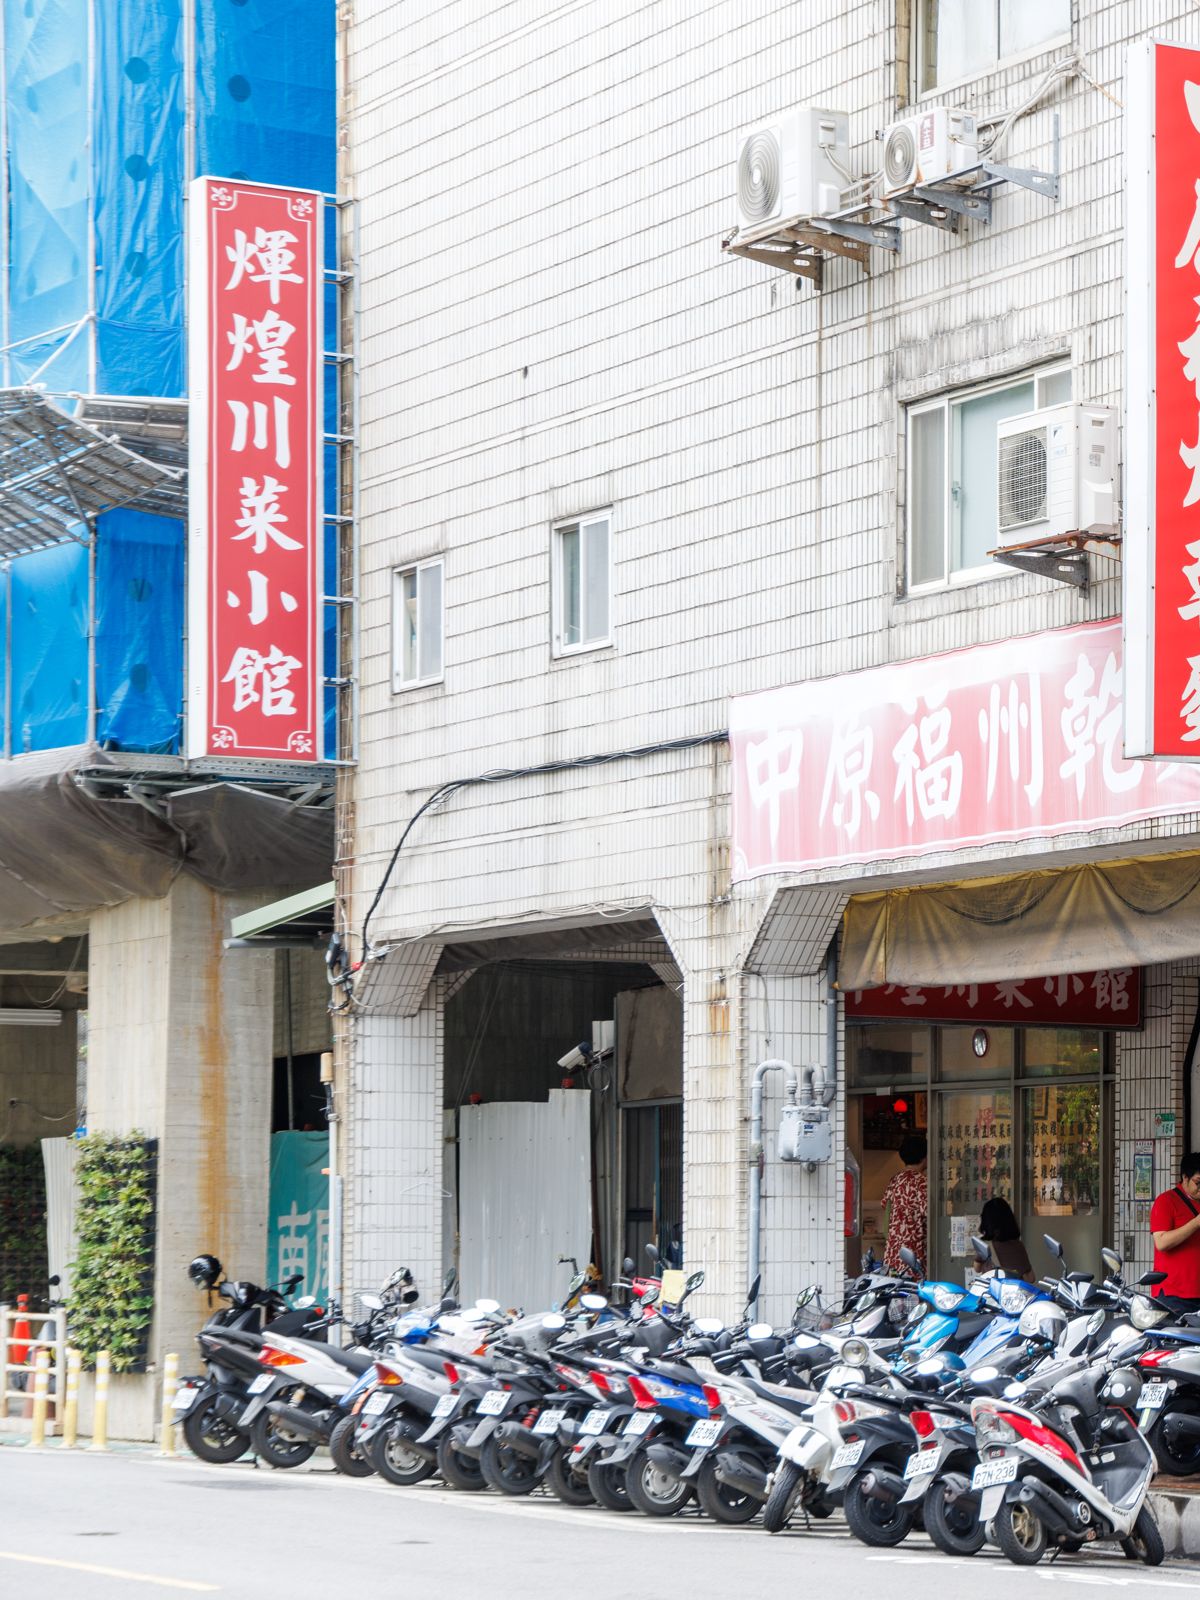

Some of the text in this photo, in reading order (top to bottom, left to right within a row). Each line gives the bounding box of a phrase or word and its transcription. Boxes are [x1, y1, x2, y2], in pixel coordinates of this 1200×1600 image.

[221, 226, 305, 717] 煇煌川菜小館
[746, 651, 1192, 846] 中原福州乾
